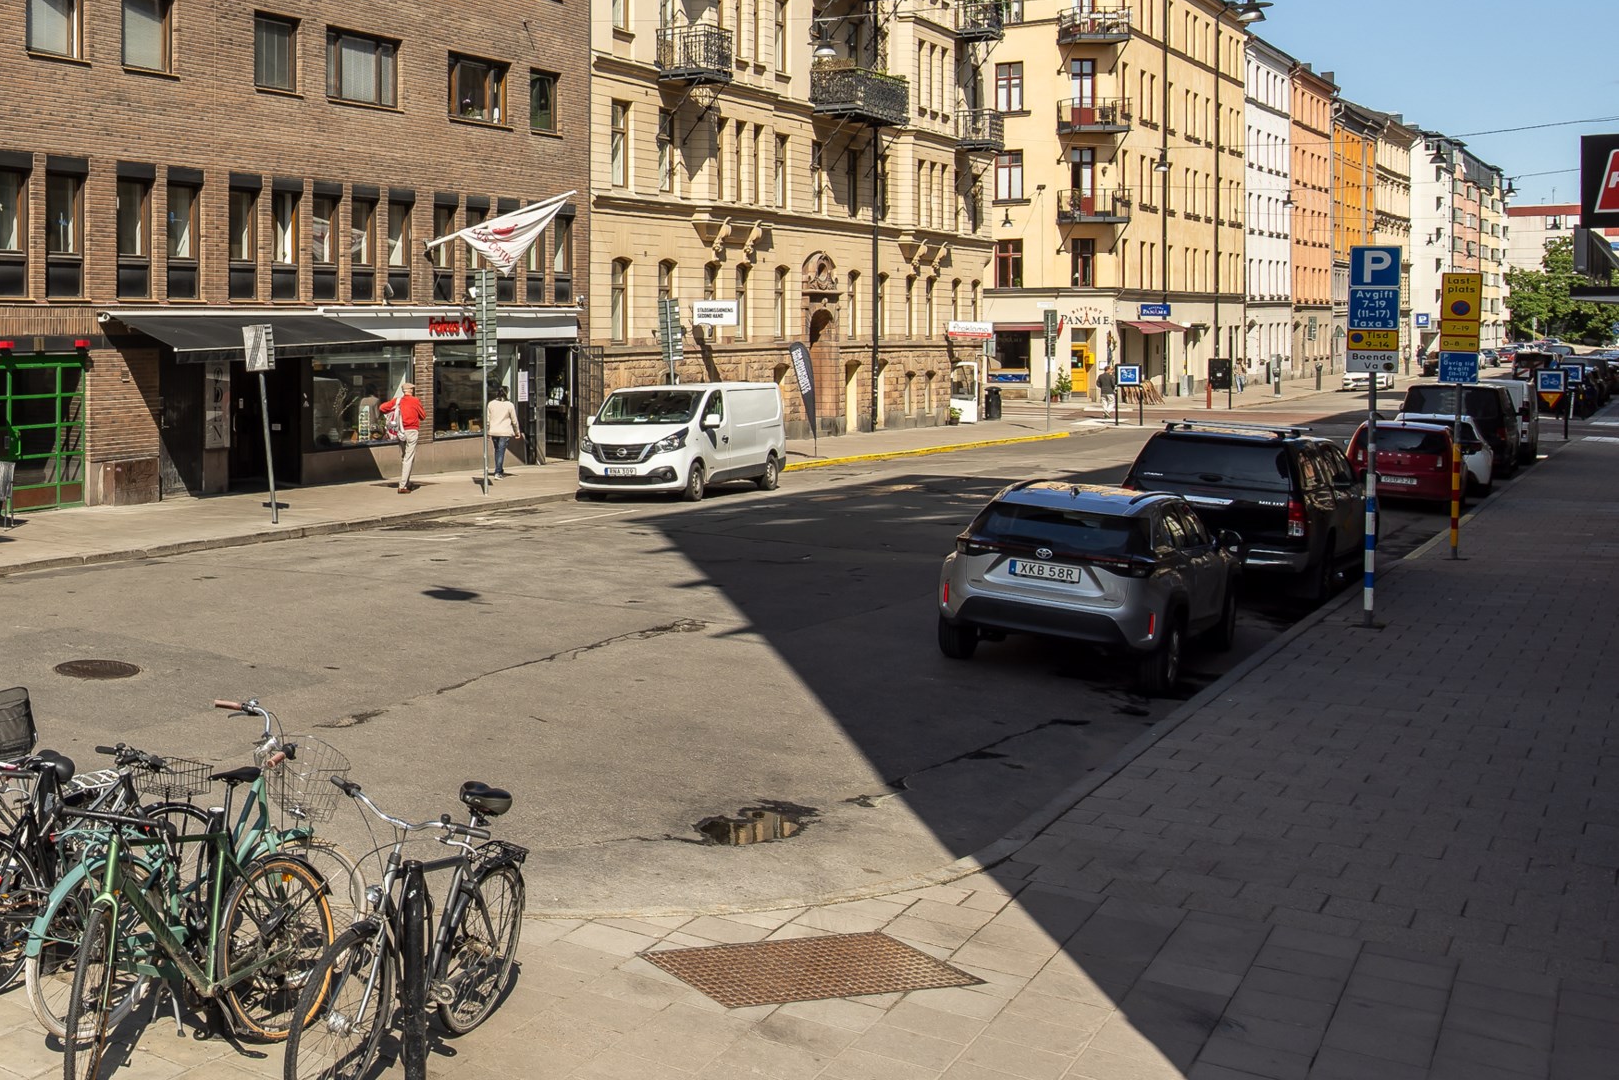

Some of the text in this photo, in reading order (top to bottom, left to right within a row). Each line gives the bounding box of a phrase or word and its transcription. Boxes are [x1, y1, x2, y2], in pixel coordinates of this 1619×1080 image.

[1363, 250, 1392, 283] P
[1447, 285, 1476, 294] plats
[1356, 290, 1393, 300] Avgift
[1362, 300, 1387, 308] 7-19
[1071, 306, 1103, 314] BISTROT
[1357, 309, 1390, 319] (11-17)
[428, 316, 460, 334] Fokus
[1353, 319, 1394, 328] Taxa 3
[1451, 324, 1470, 332] 7-19
[1367, 331, 1389, 339] Tisd
[1365, 340, 1390, 348] 9-14
[1352, 352, 1393, 361] Boende
[1020, 563, 1074, 580] XKB 58R
